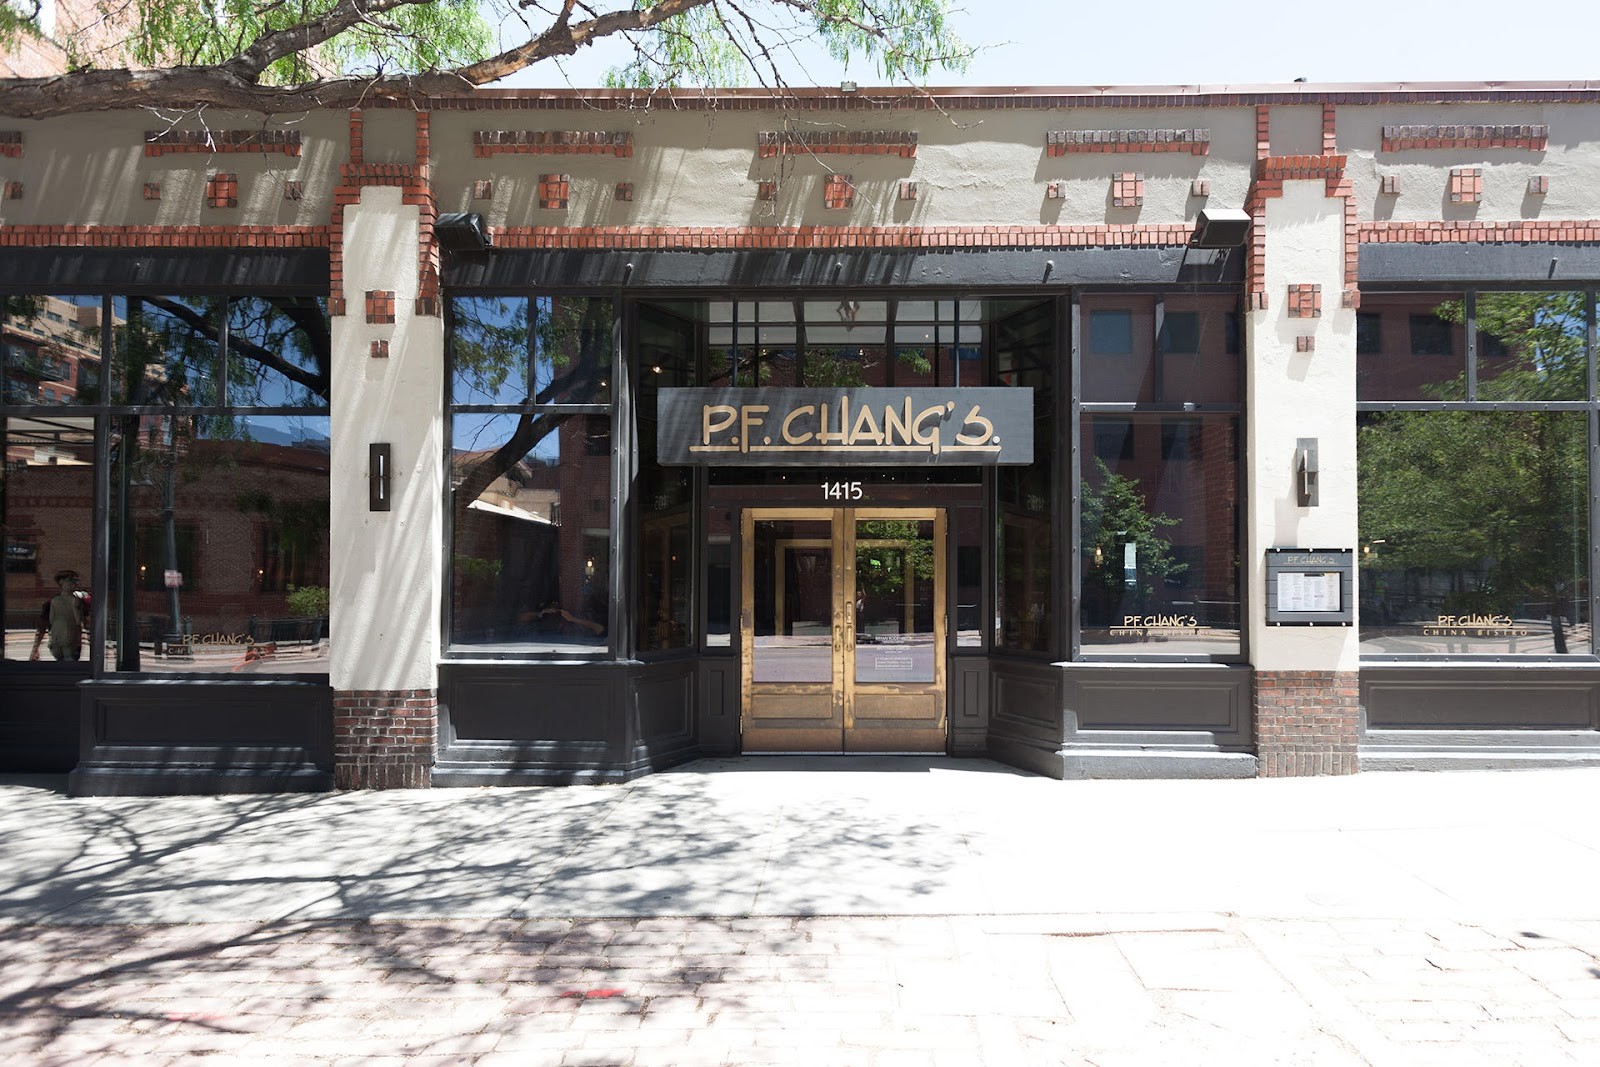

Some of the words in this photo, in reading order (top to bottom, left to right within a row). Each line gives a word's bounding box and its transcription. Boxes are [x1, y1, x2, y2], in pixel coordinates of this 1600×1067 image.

[703, 404, 771, 453] P.F.
[821, 481, 863, 500] 1415
[1144, 613, 1198, 629] CHANG'S
[1458, 613, 1513, 628] CHANG'S
[202, 632, 254, 645] CHANG'S
